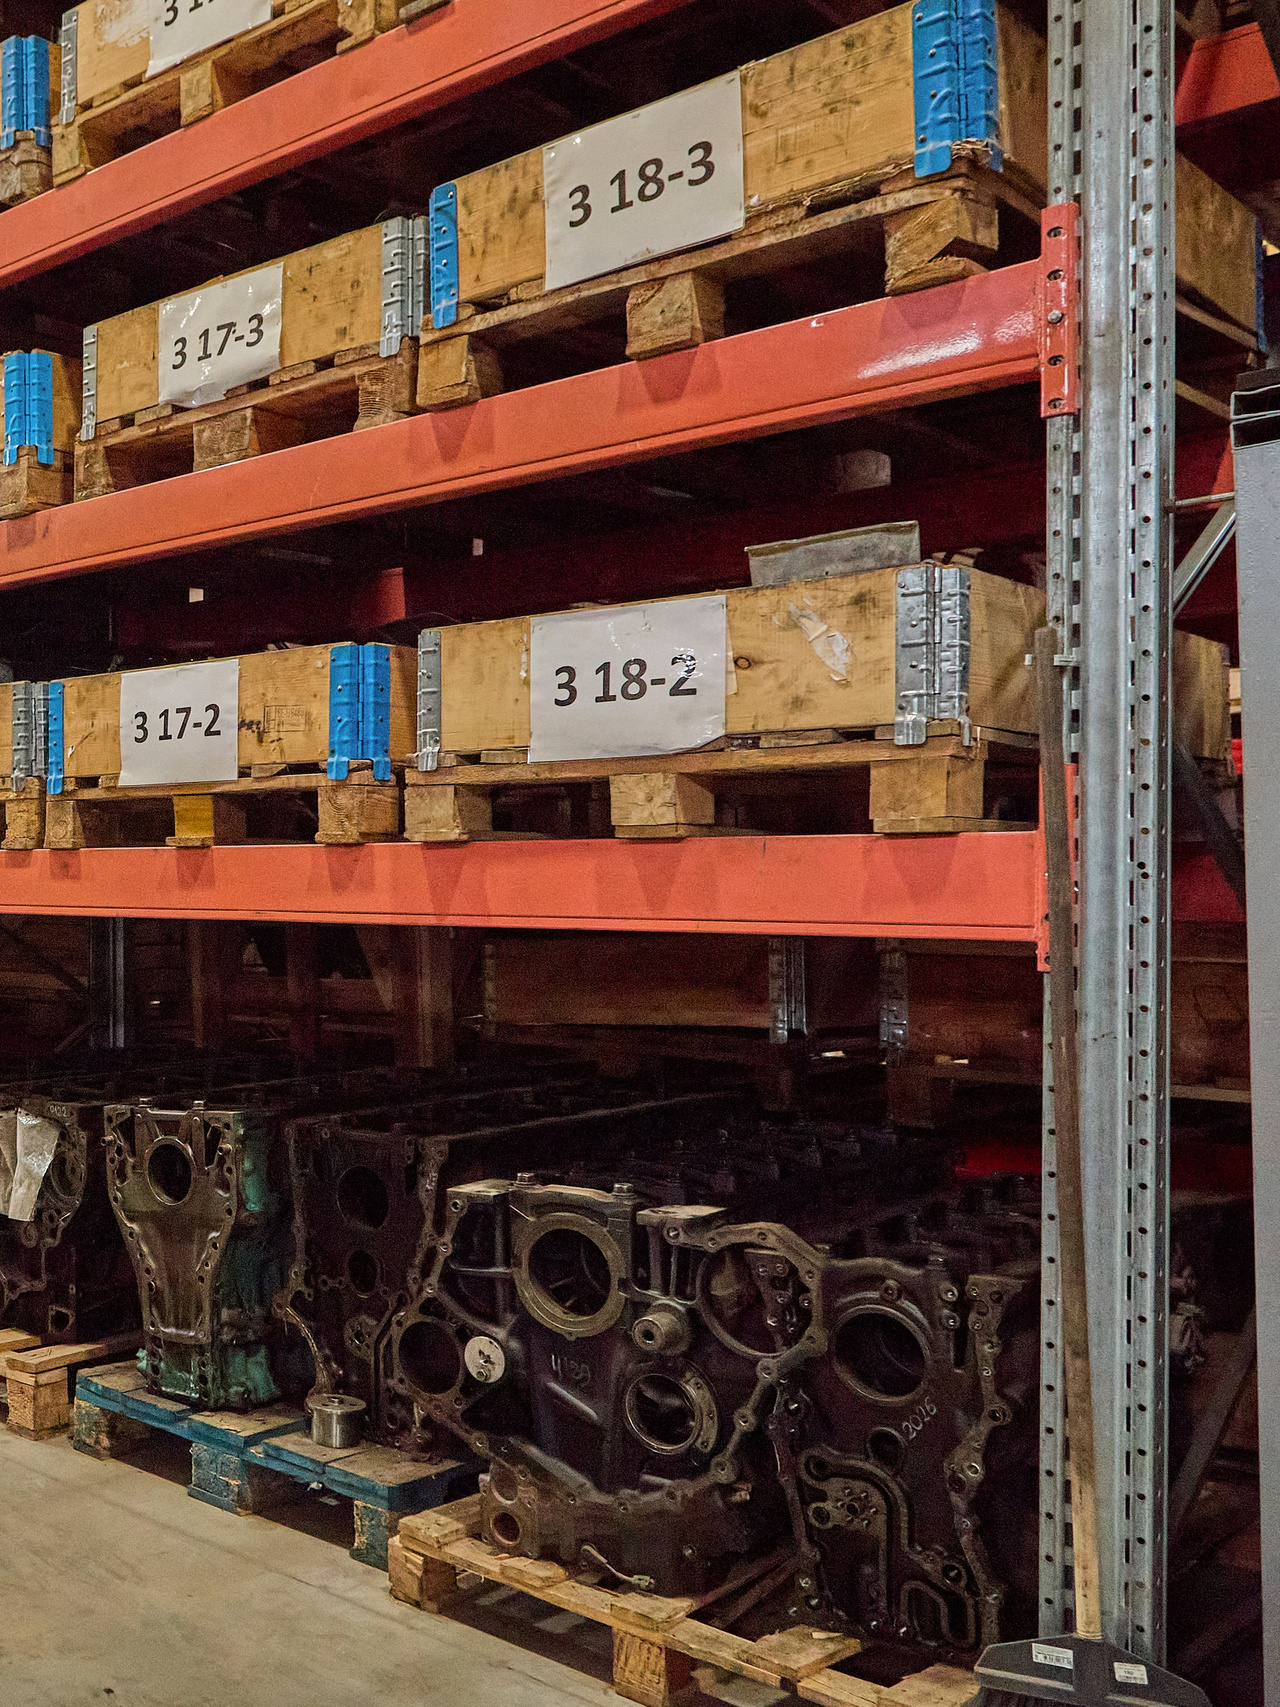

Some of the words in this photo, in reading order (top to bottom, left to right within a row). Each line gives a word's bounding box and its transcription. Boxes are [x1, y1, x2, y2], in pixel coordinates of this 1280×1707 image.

[569, 184, 591, 228] 3
[610, 140, 715, 214] 18-3
[172, 336, 187, 370] 3
[198, 313, 264, 362] 17-3
[554, 664, 578, 708] 3
[594, 654, 697, 704] 18-2
[134, 711, 149, 744] 3
[158, 703, 221, 741] 17-2
